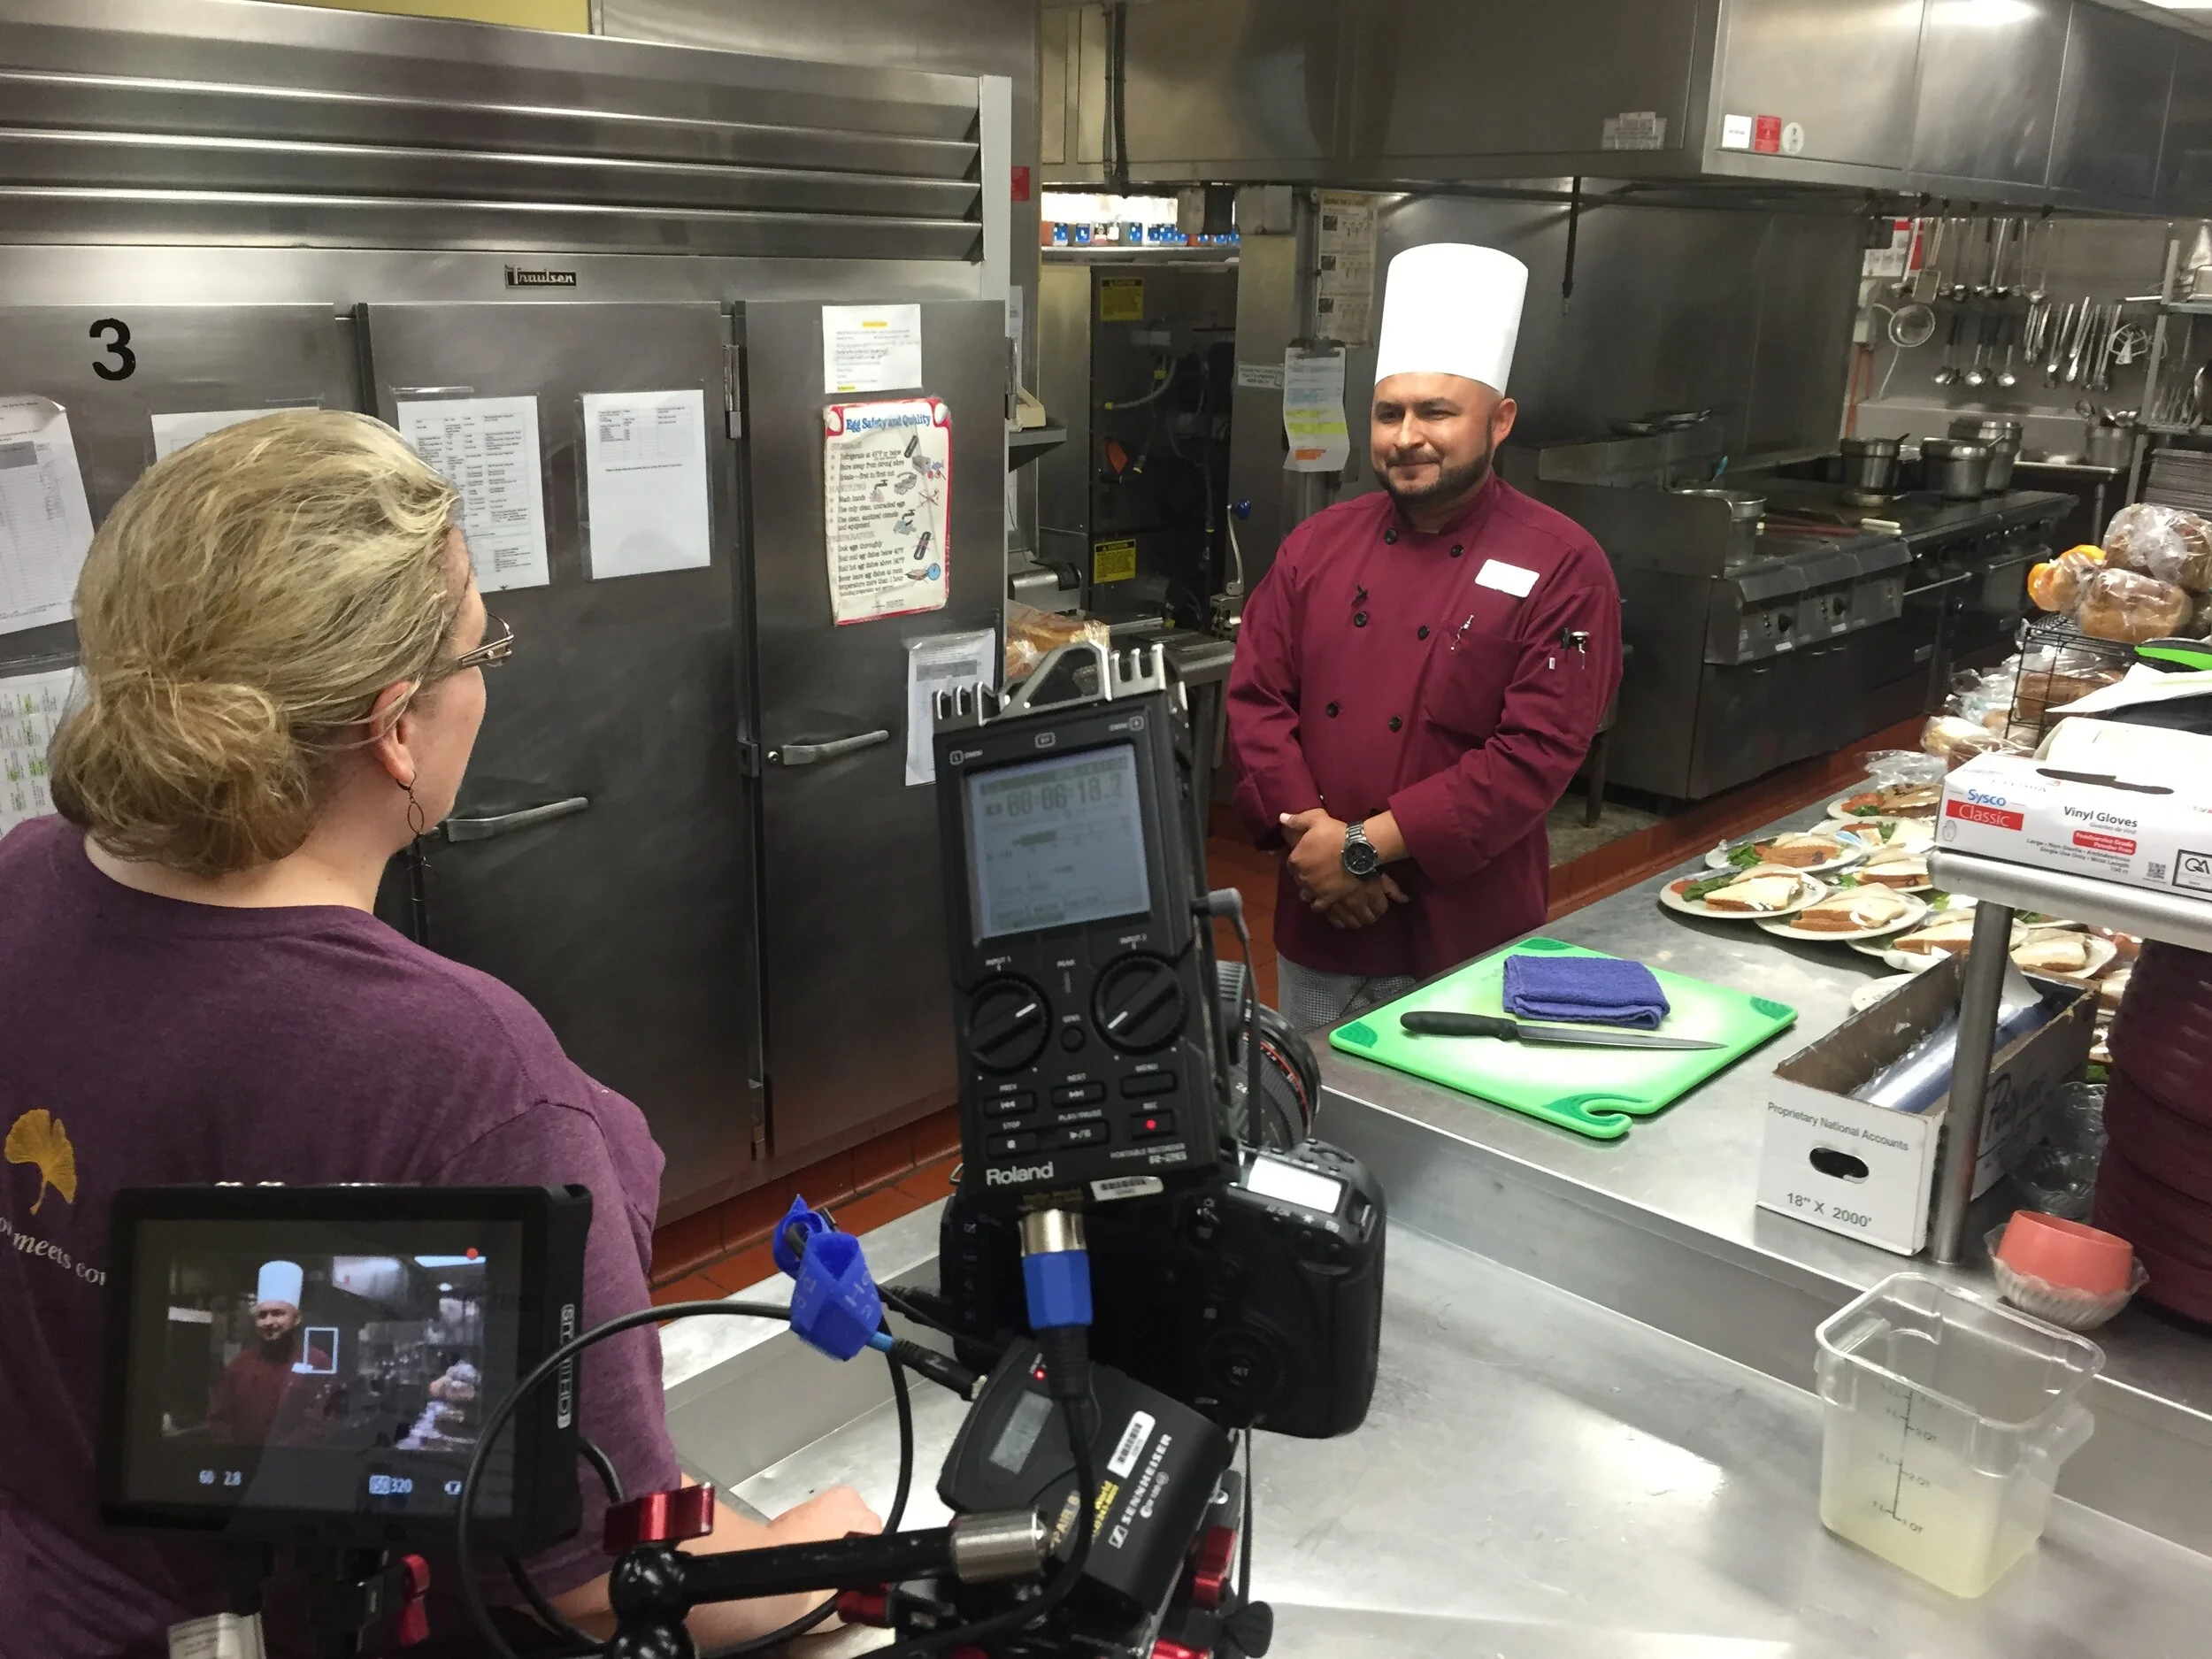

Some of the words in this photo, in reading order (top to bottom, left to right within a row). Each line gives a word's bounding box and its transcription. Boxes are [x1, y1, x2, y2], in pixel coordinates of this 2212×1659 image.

[89, 317, 137, 381] 3
[846, 419, 861, 433] Egg
[862, 417, 887, 430] Safety
[887, 416, 902, 427] and
[902, 413, 931, 427] Quality
[1967, 788, 2007, 807] Sysco
[1959, 804, 2010, 827] Classic
[2063, 806, 2094, 821] Vinyl
[2096, 812, 2139, 828] Gloves
[2026, 838, 2044, 847] Large
[2039, 846, 2059, 855] Single
[2071, 852, 2085, 861] Only
[1767, 1102, 1819, 1127] Proprietary
[1820, 1117, 1860, 1137] National
[1862, 1130, 1910, 1151] Accounts
[986, 1161, 1054, 1187] Roland
[13, 1233, 72, 1270] meets
[1121, 1433, 1173, 1525] SENNHEISER
